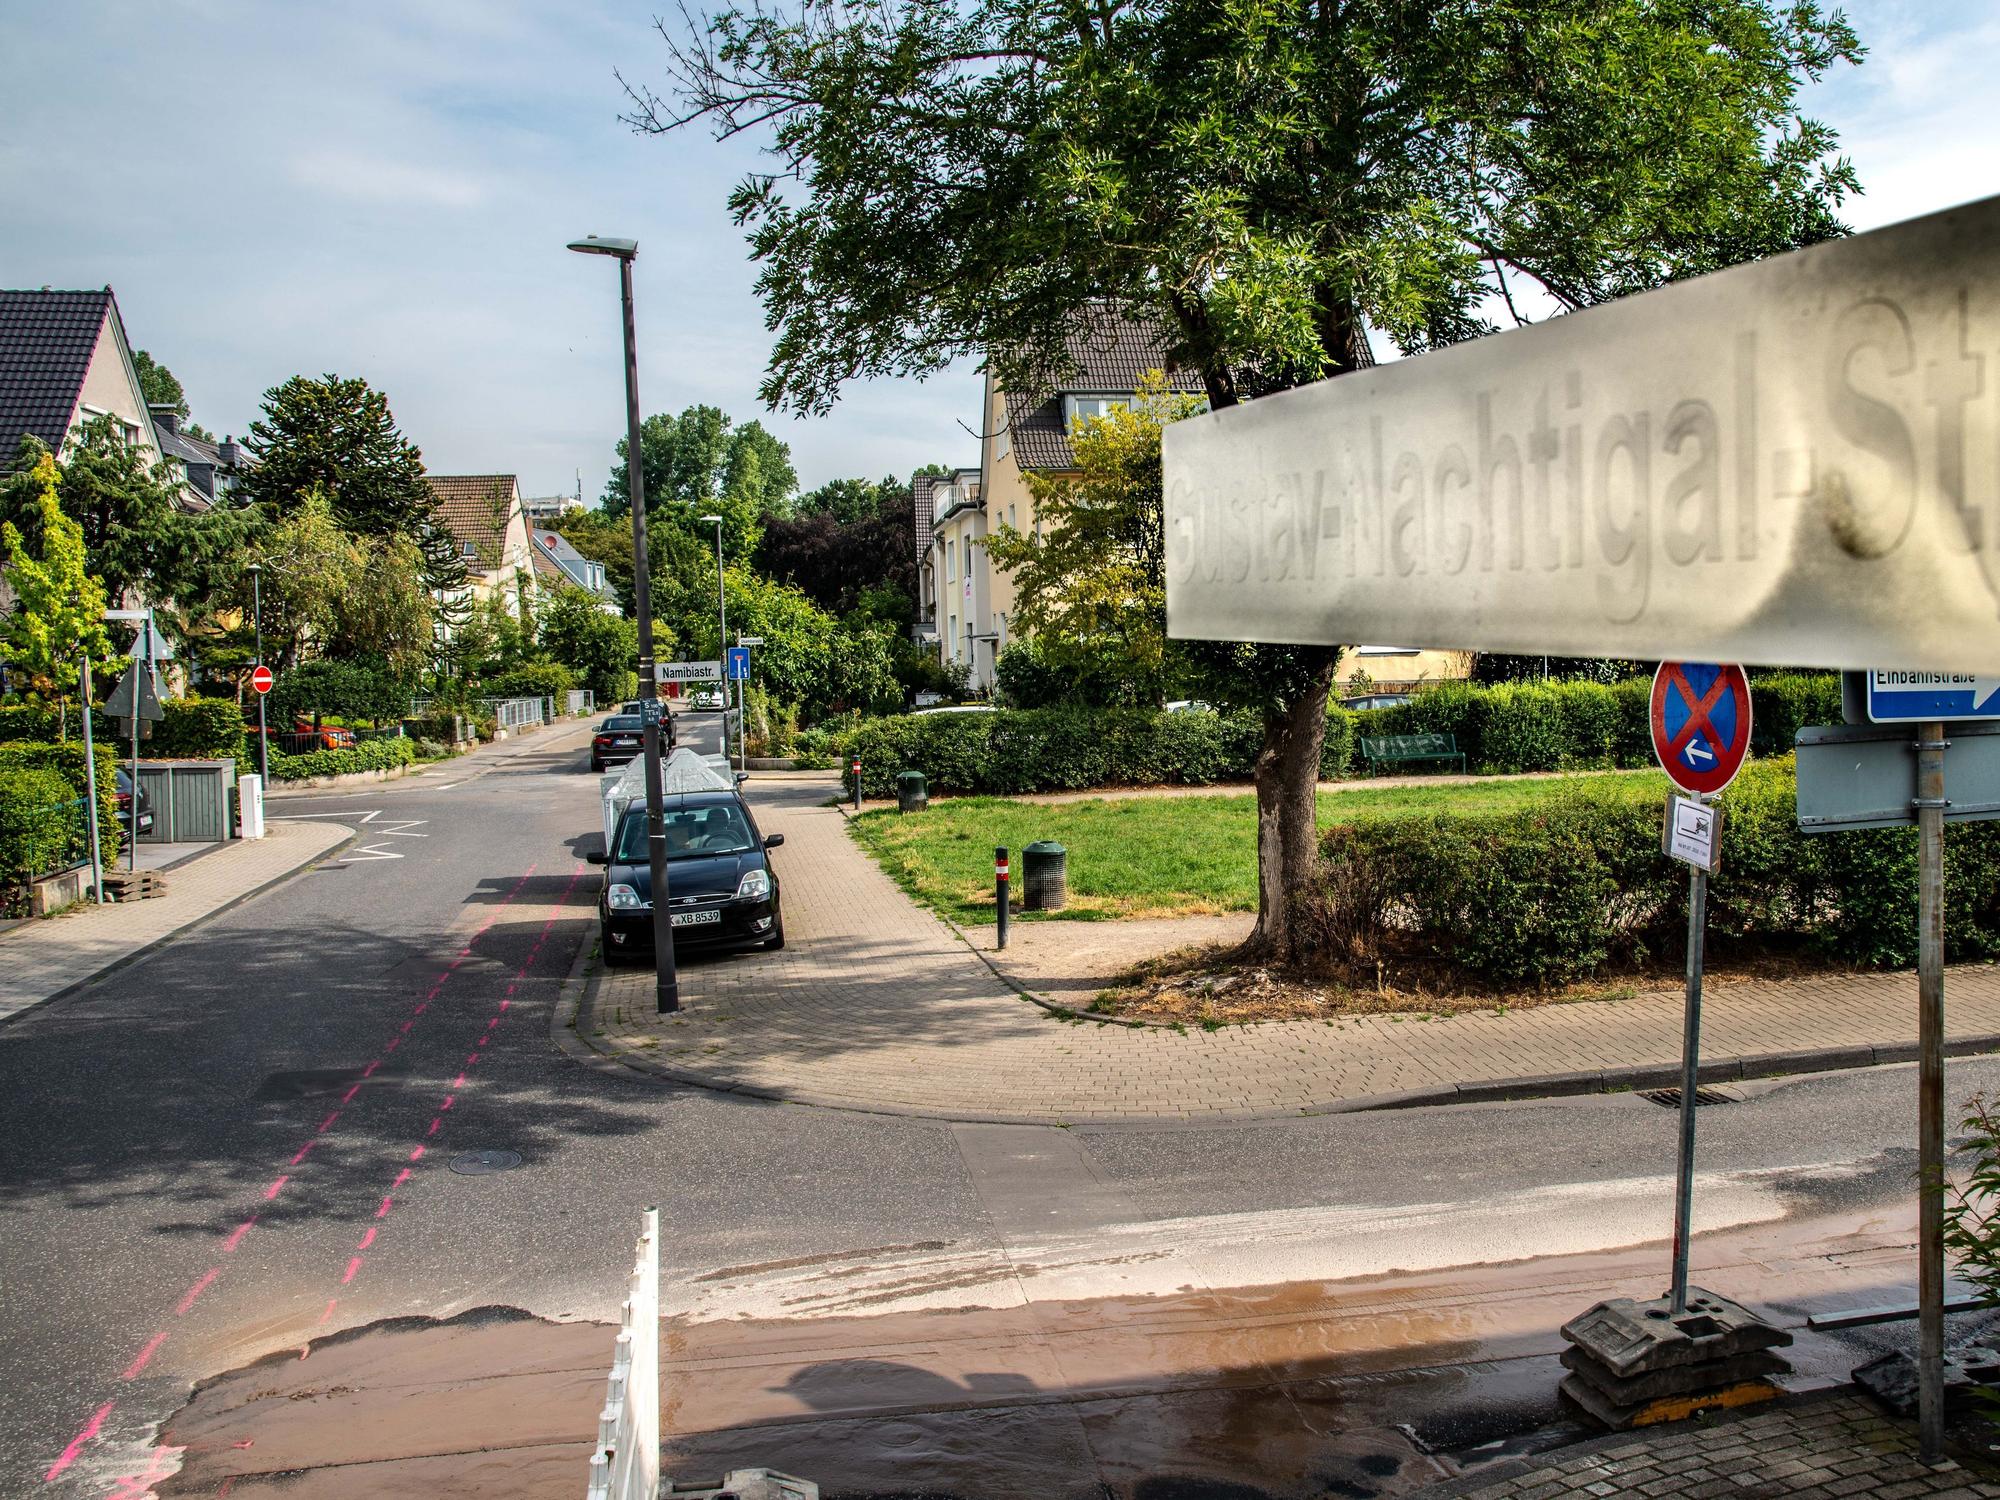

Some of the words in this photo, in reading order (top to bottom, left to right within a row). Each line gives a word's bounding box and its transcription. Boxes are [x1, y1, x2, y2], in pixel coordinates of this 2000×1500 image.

[1168, 286, 2000, 626] Gustav-Nachtigal-St
[662, 666, 714, 679] Namibiastr.
[680, 914, 693, 924] XB
[695, 911, 719, 923] 8539
